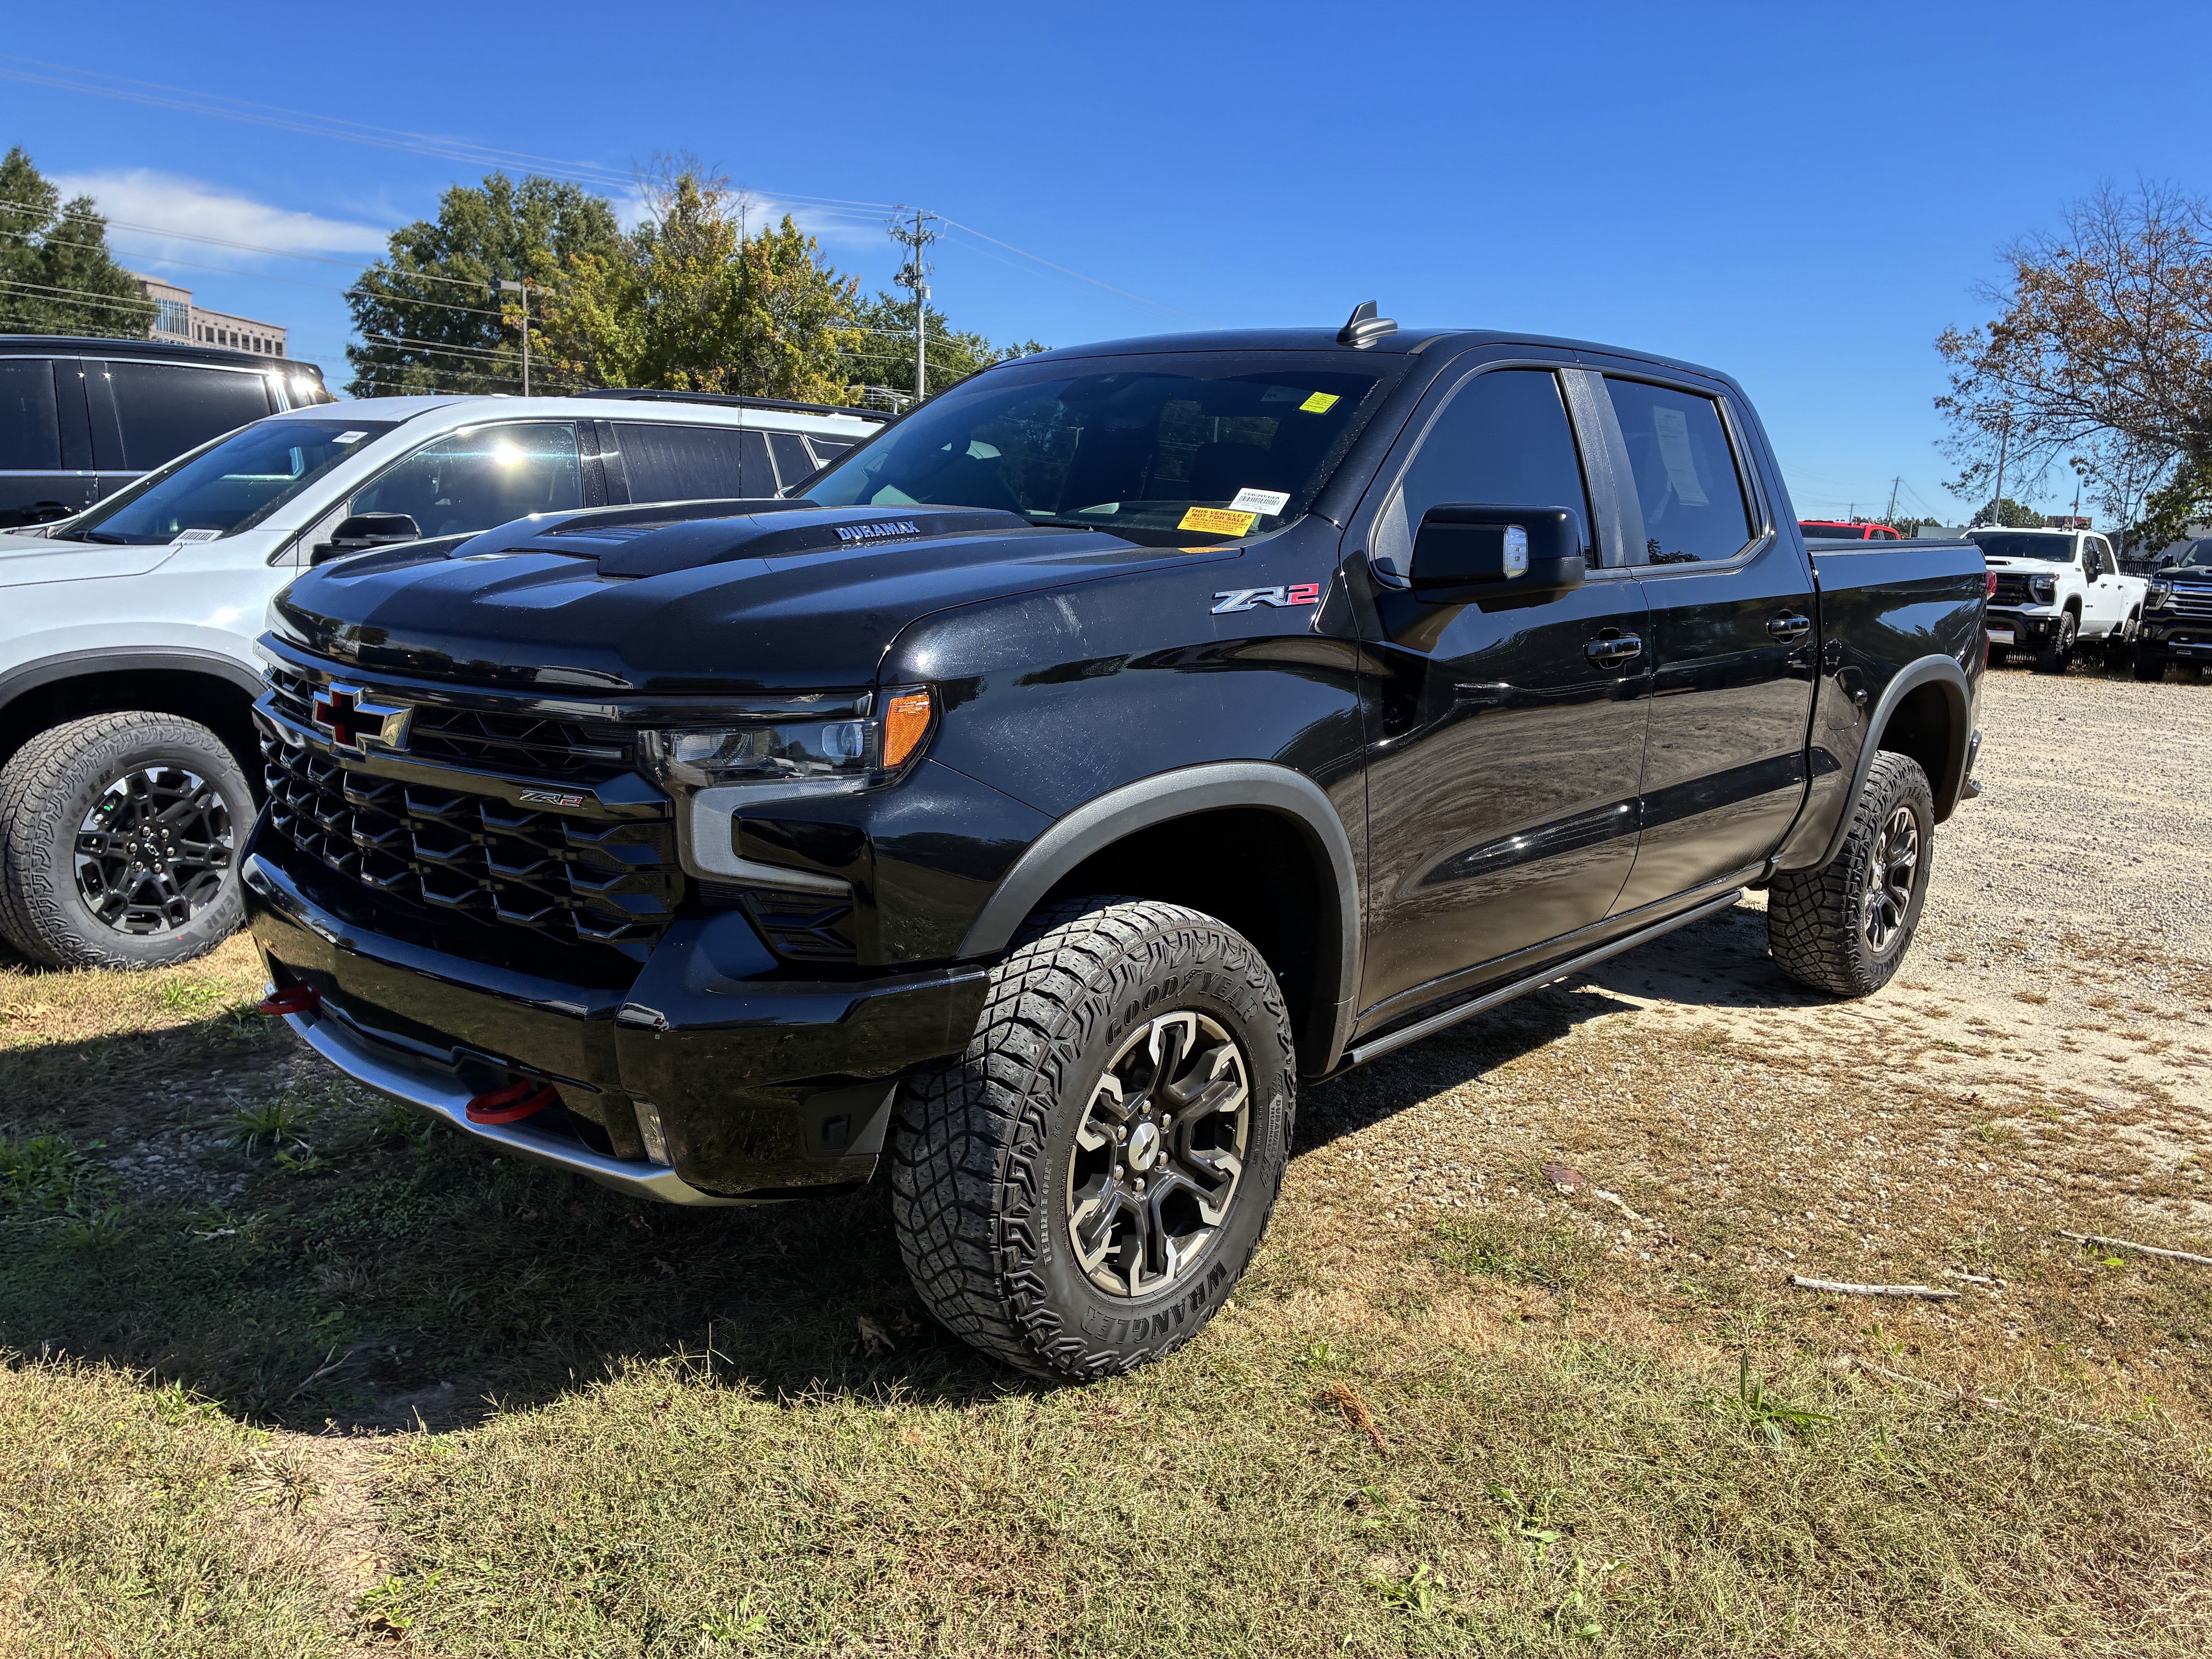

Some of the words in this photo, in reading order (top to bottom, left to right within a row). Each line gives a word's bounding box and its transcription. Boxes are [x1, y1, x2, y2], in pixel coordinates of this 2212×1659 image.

[833, 521, 921, 541] DURAMAX
[1209, 583, 1319, 615] ZR2
[519, 790, 583, 807] ZR2
[1105, 968, 1259, 1046] GOODYEAR
[1267, 1106, 1275, 1153] TECHNOLOGY
[1271, 1099, 1281, 1159] DURAWALL
[1039, 1154, 1053, 1266] TERRITORY
[1080, 1259, 1228, 1344] WRANGLER
